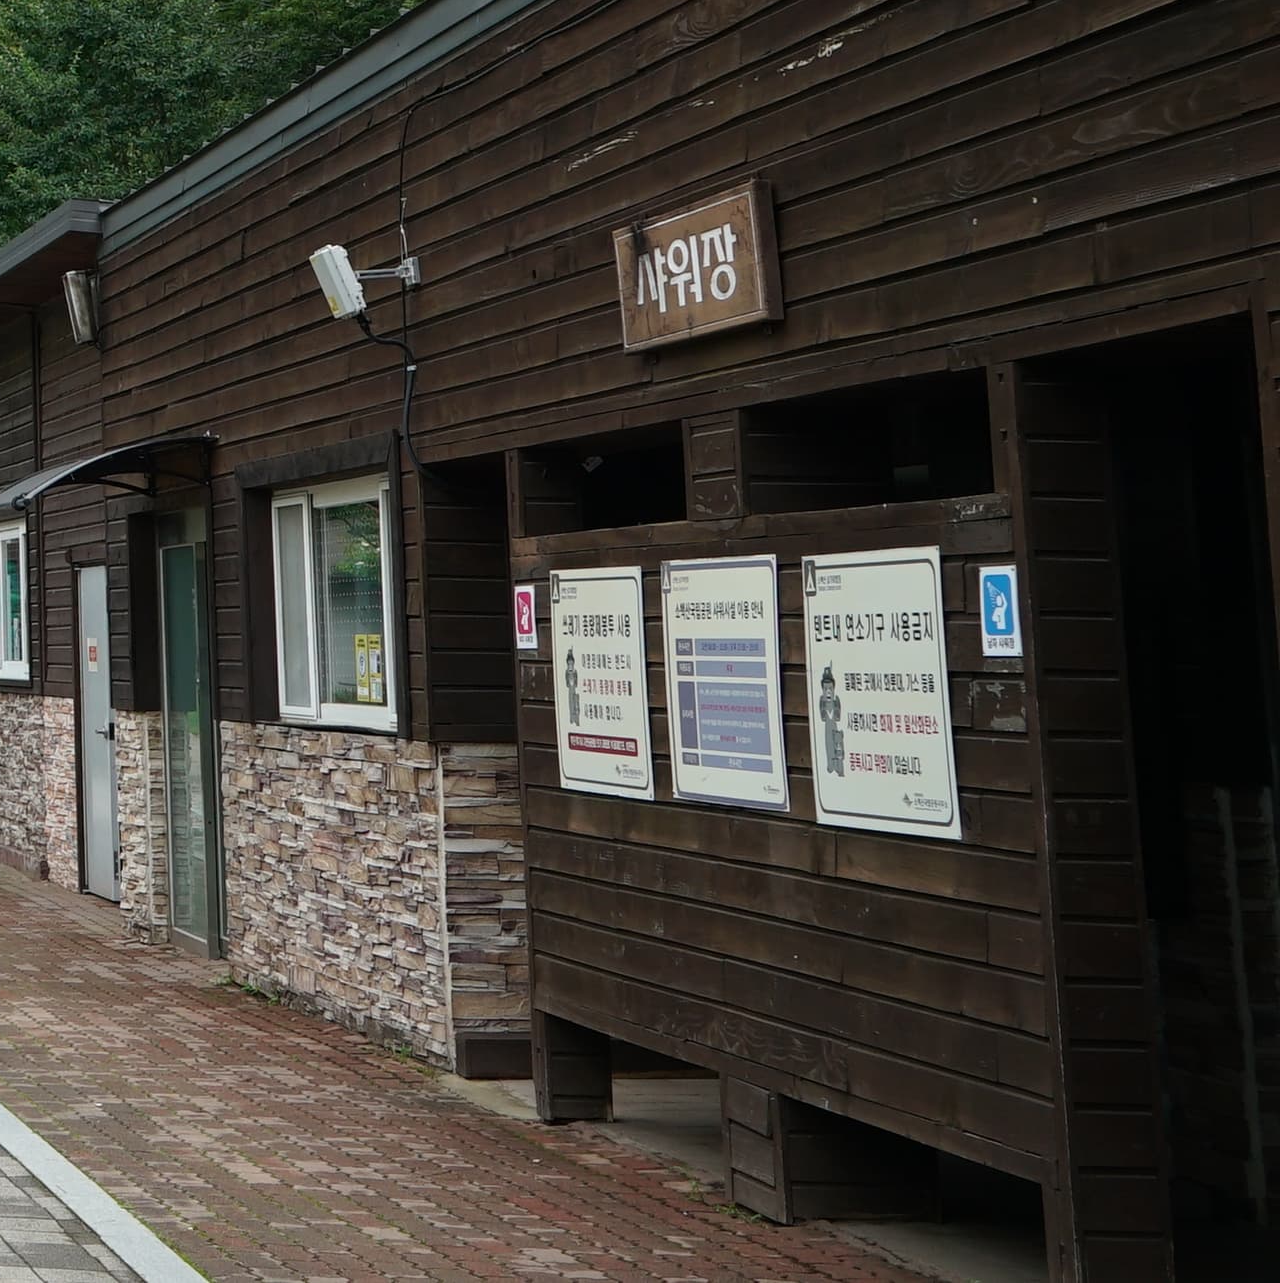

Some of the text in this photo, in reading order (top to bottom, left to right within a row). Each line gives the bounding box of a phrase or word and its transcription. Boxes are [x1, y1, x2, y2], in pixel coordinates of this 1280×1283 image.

[637, 223, 737, 313] 샤워장
[563, 614, 580, 637] 쓰레기
[617, 614, 631, 638] 사용
[814, 611, 933, 642] 텐트내 연소기구 사용금지
[921, 673, 935, 693] 등을
[904, 714, 939, 735] 일산화탄소
